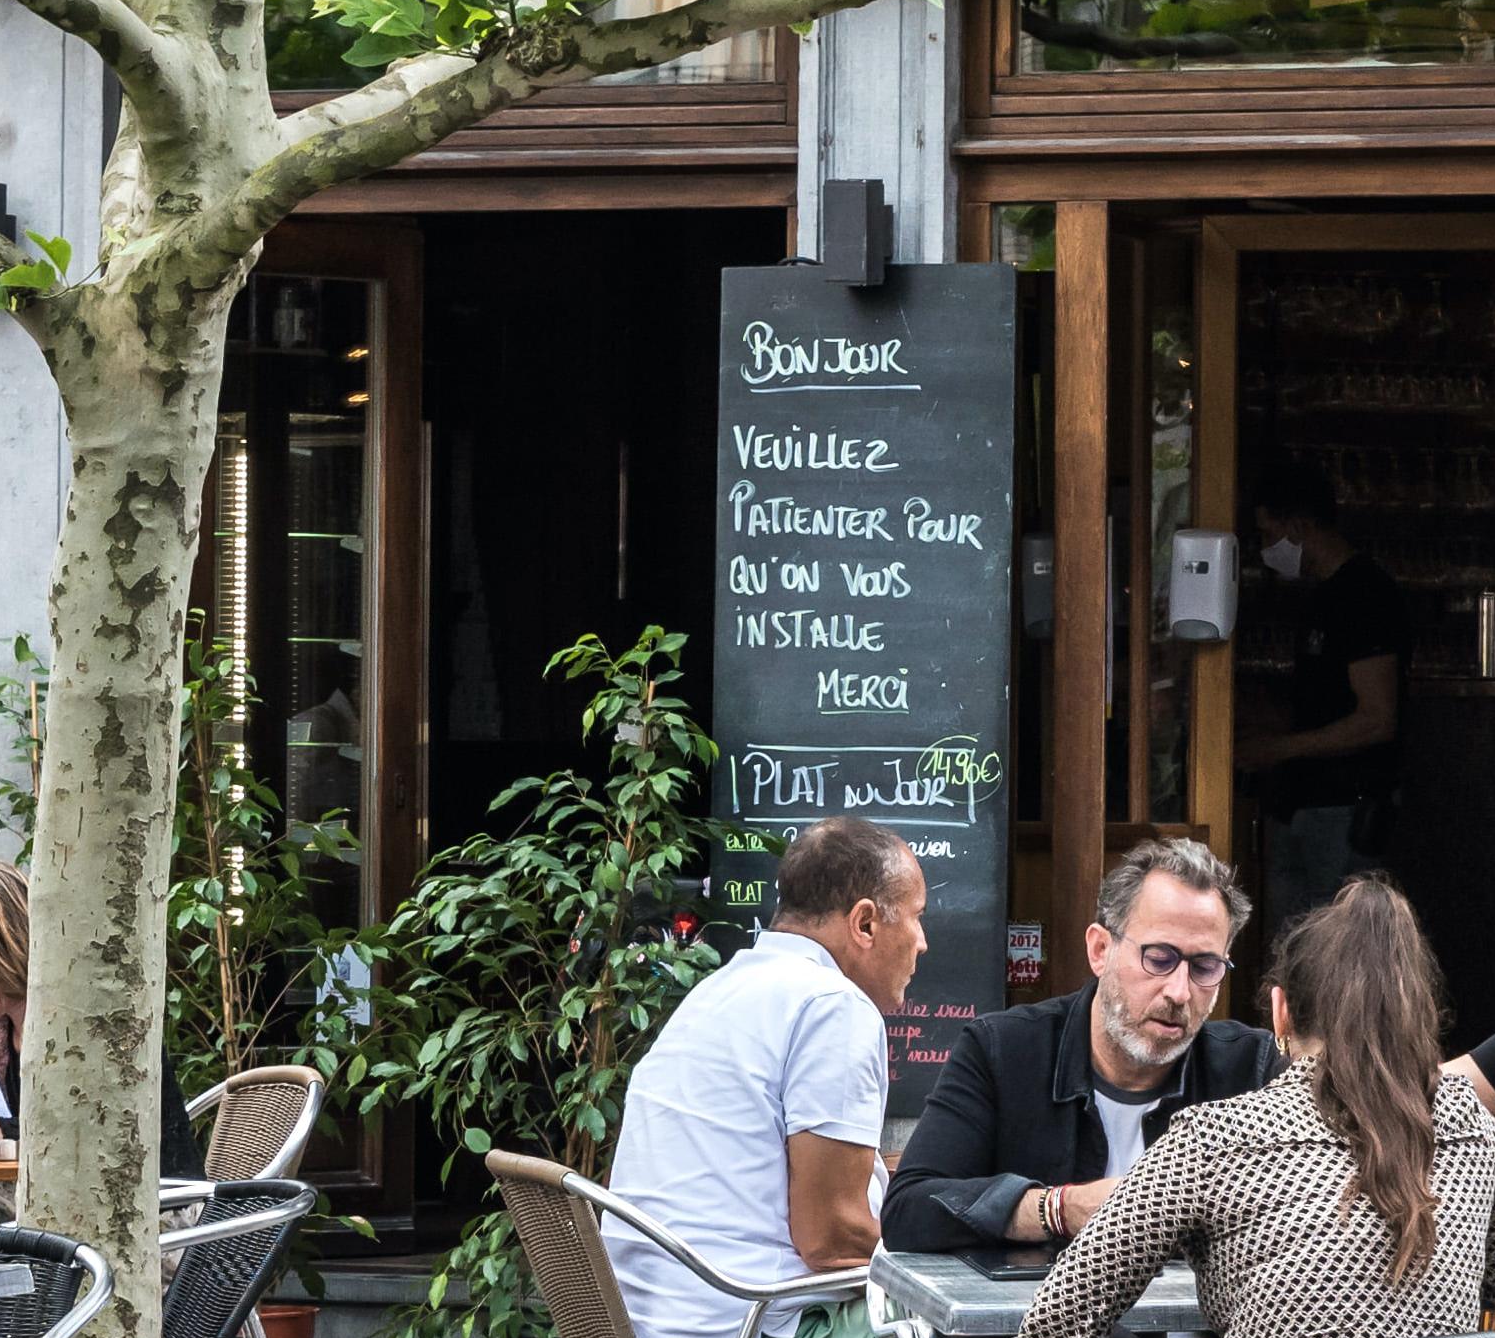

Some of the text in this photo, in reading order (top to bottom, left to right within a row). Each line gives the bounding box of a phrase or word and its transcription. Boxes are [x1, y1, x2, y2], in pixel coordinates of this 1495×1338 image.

[741, 321, 908, 384] BONJOUR
[903, 496, 984, 550] POUR
[840, 561, 912, 599] VOUS
[742, 751, 955, 809] PLAT DU JOUR
[724, 880, 768, 902] PLAT
[1010, 934, 1039, 948] 2012
